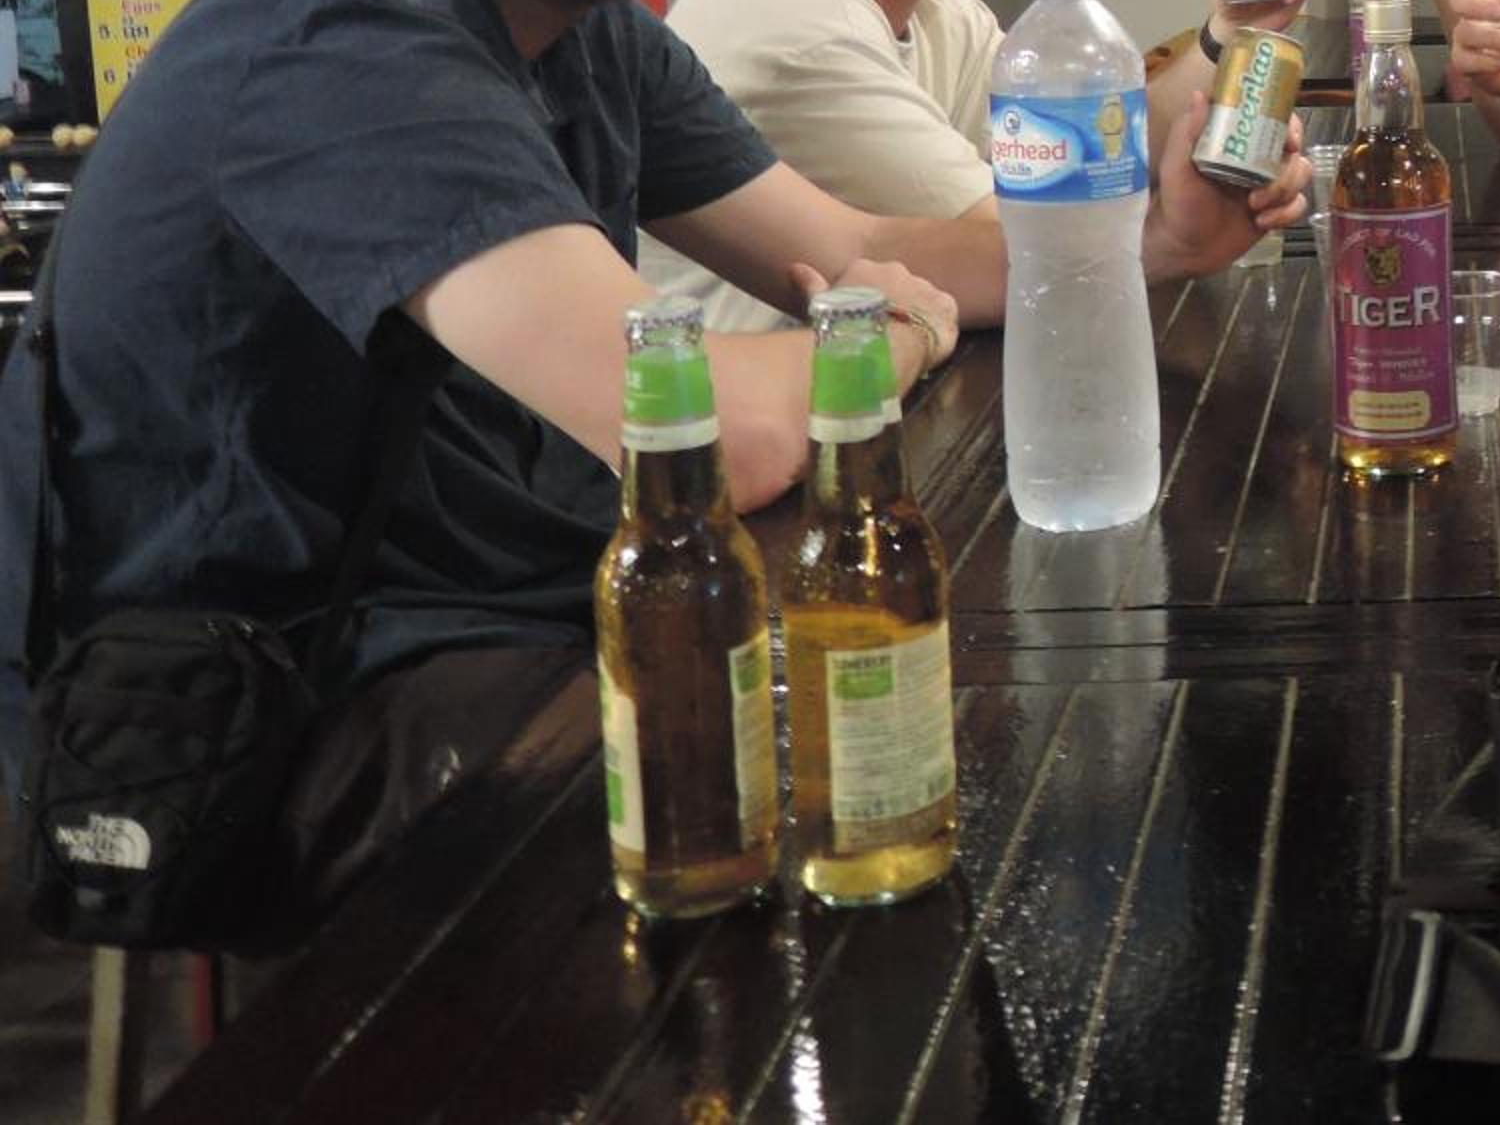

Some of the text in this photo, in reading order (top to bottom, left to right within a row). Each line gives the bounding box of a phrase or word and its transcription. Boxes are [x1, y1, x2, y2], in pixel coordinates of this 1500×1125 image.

[125, 45, 147, 59] Ch
[1222, 41, 1274, 161] Beerlao
[1337, 282, 1441, 328] TIGER
